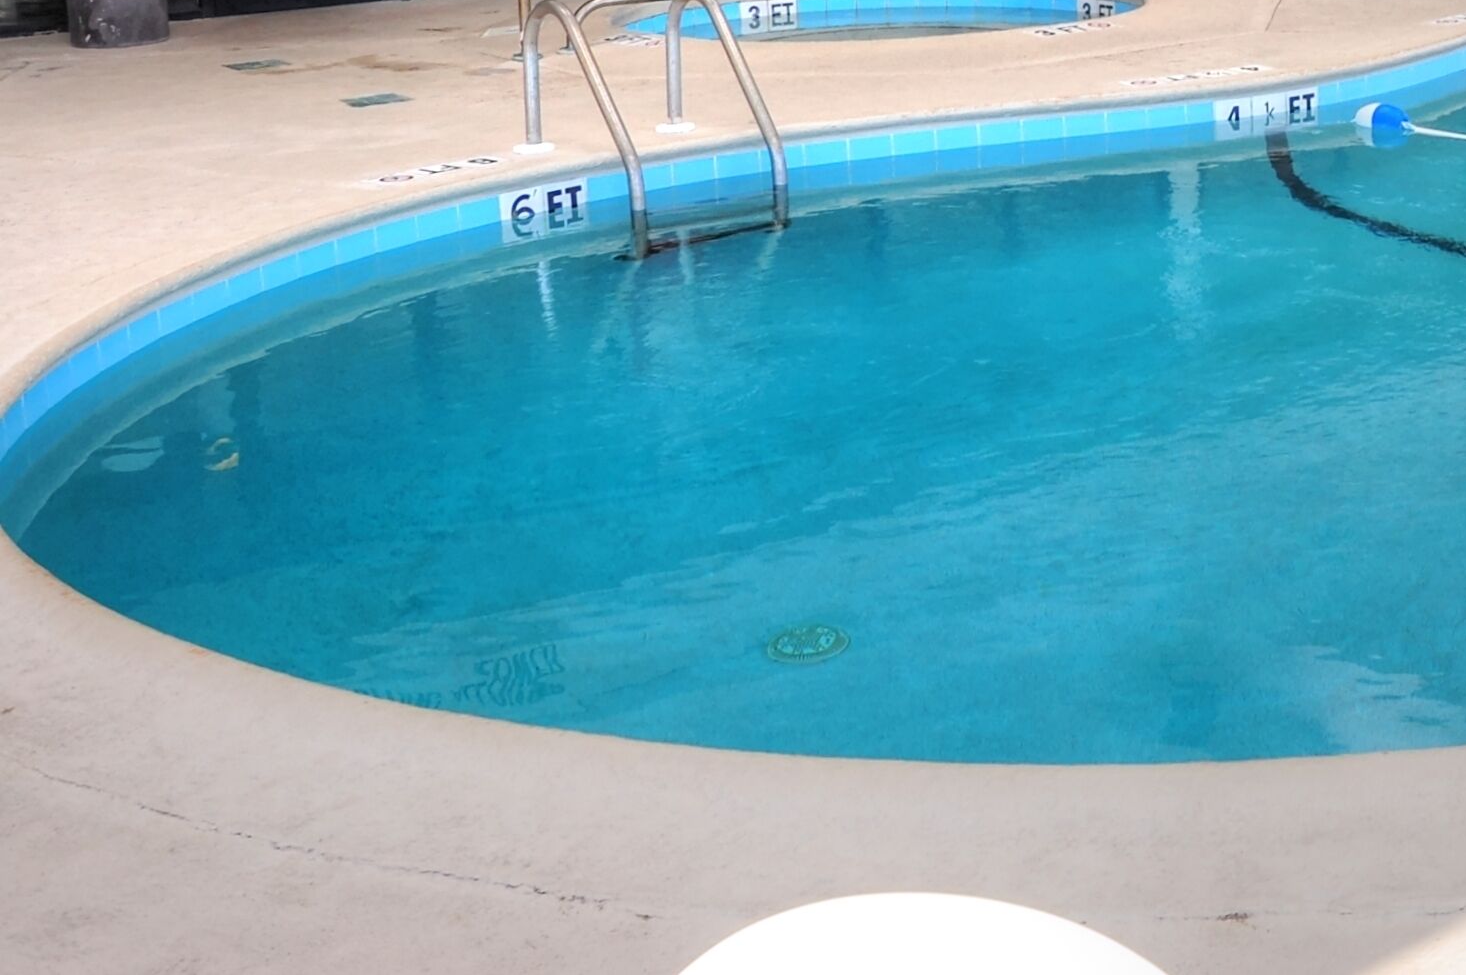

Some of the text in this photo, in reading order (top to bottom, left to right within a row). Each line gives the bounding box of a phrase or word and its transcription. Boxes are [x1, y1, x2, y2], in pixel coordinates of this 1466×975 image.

[749, 6, 761, 29] 3
[1082, 3, 1091, 20] 3
[511, 194, 535, 237] 6
